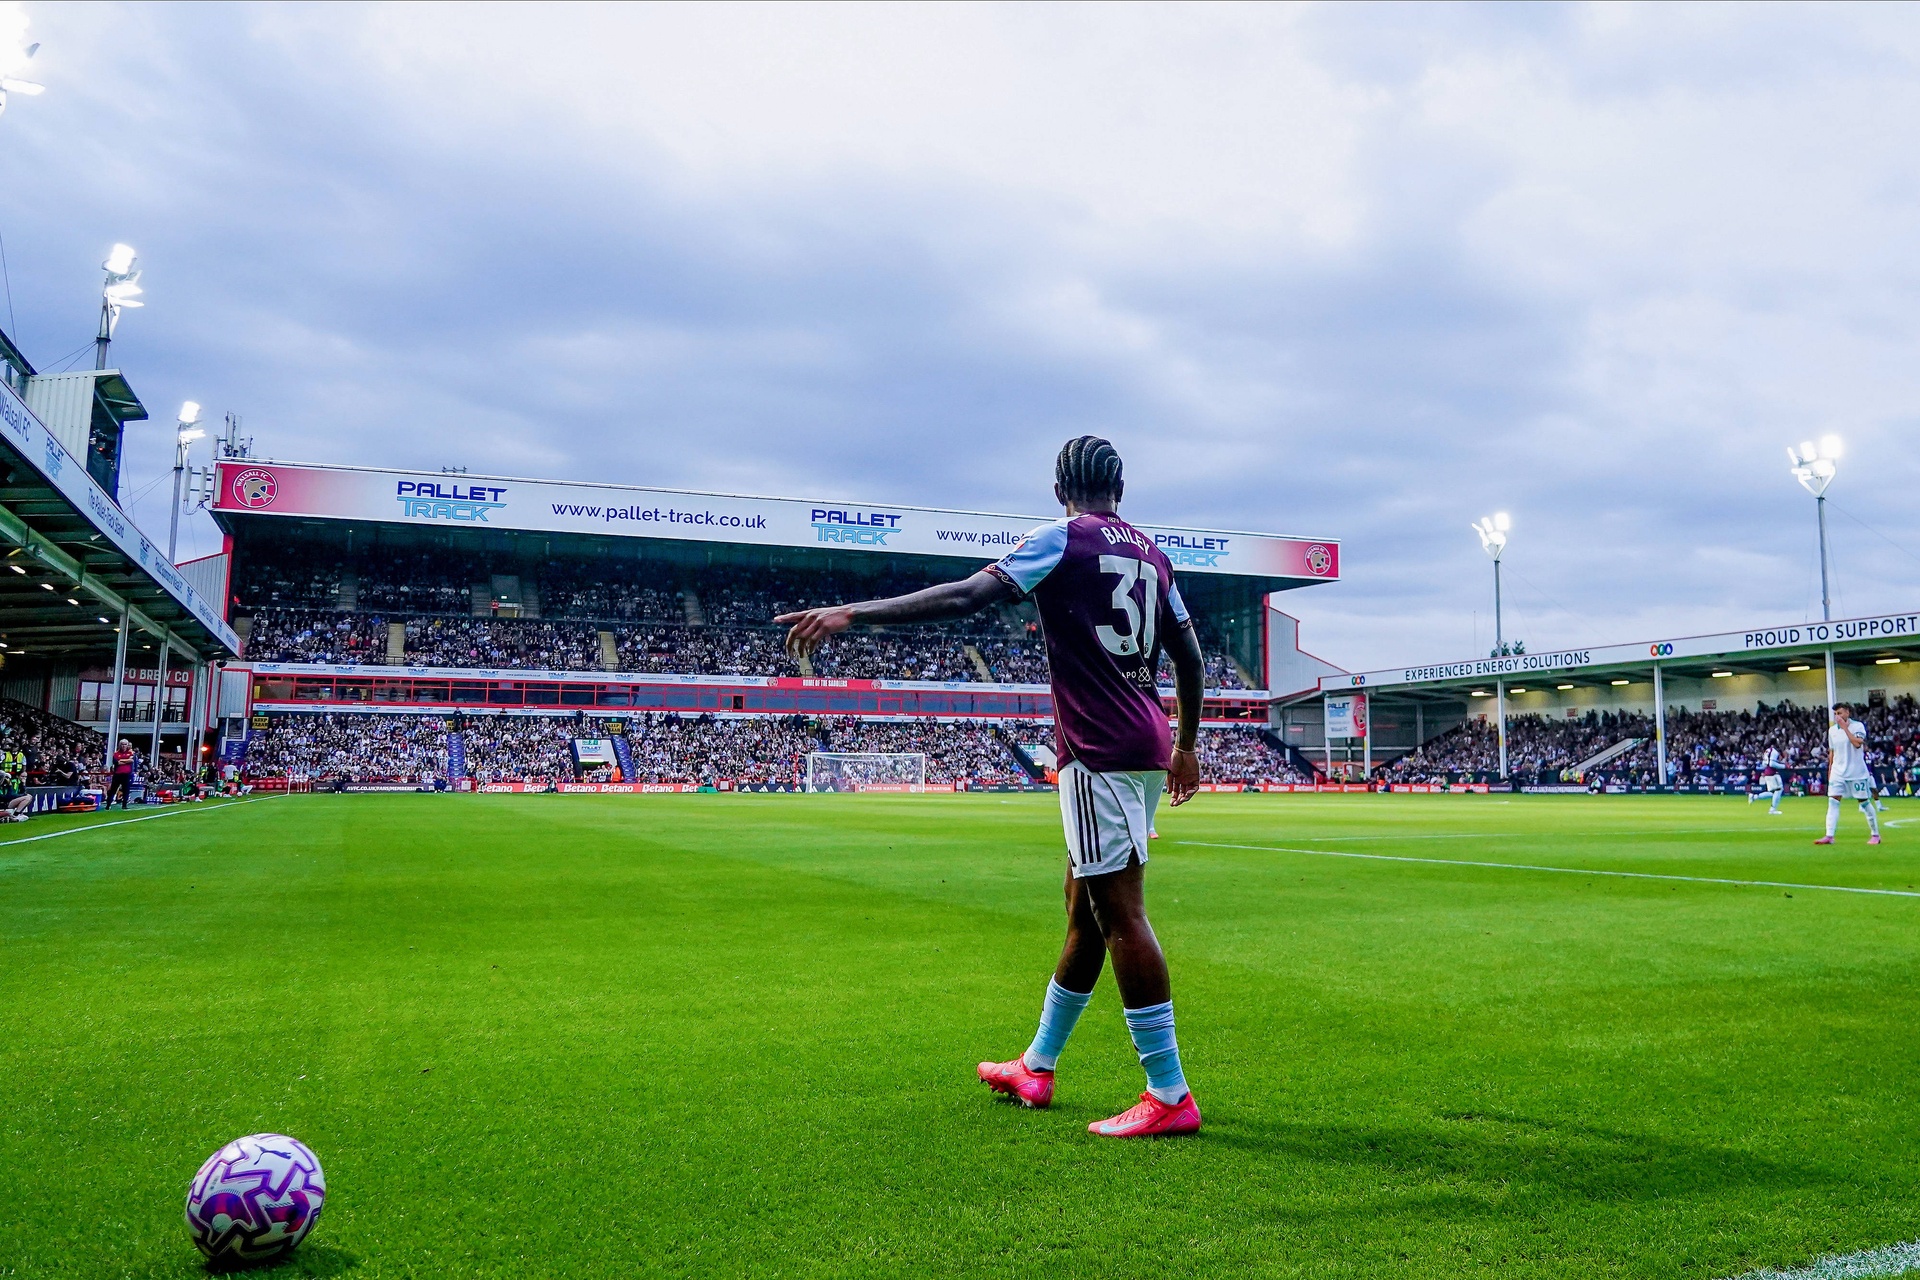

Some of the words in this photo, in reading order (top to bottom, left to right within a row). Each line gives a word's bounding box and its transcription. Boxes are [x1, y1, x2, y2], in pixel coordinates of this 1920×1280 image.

[22, 414, 31, 442] FC
[46, 437, 64, 461] PALLET
[236, 471, 259, 486] WALSALL
[397, 481, 507, 502] PALLET
[397, 496, 507, 521] TRACK
[552, 503, 767, 529] www.pallet-track.co.uk
[811, 508, 902, 527] PALLET
[811, 523, 902, 546] TRACK
[936, 529, 1023, 546] www.palle
[1100, 526, 1149, 556] BAILEY
[1154, 534, 1230, 551] PALLET
[1095, 555, 1158, 659] 31
[1745, 629, 1800, 648] PROUD
[1806, 626, 1829, 641] TO
[1836, 616, 1918, 639] SUPPORT
[174, 671, 189, 683] CO
[1405, 663, 1473, 681] EXPERIENCED
[1476, 657, 1519, 674] ENERGY
[1523, 651, 1590, 670] SOLUTIONS
[564, 784, 597, 793] Betano
[601, 784, 634, 793] Betano
[642, 784, 674, 793] Betano
